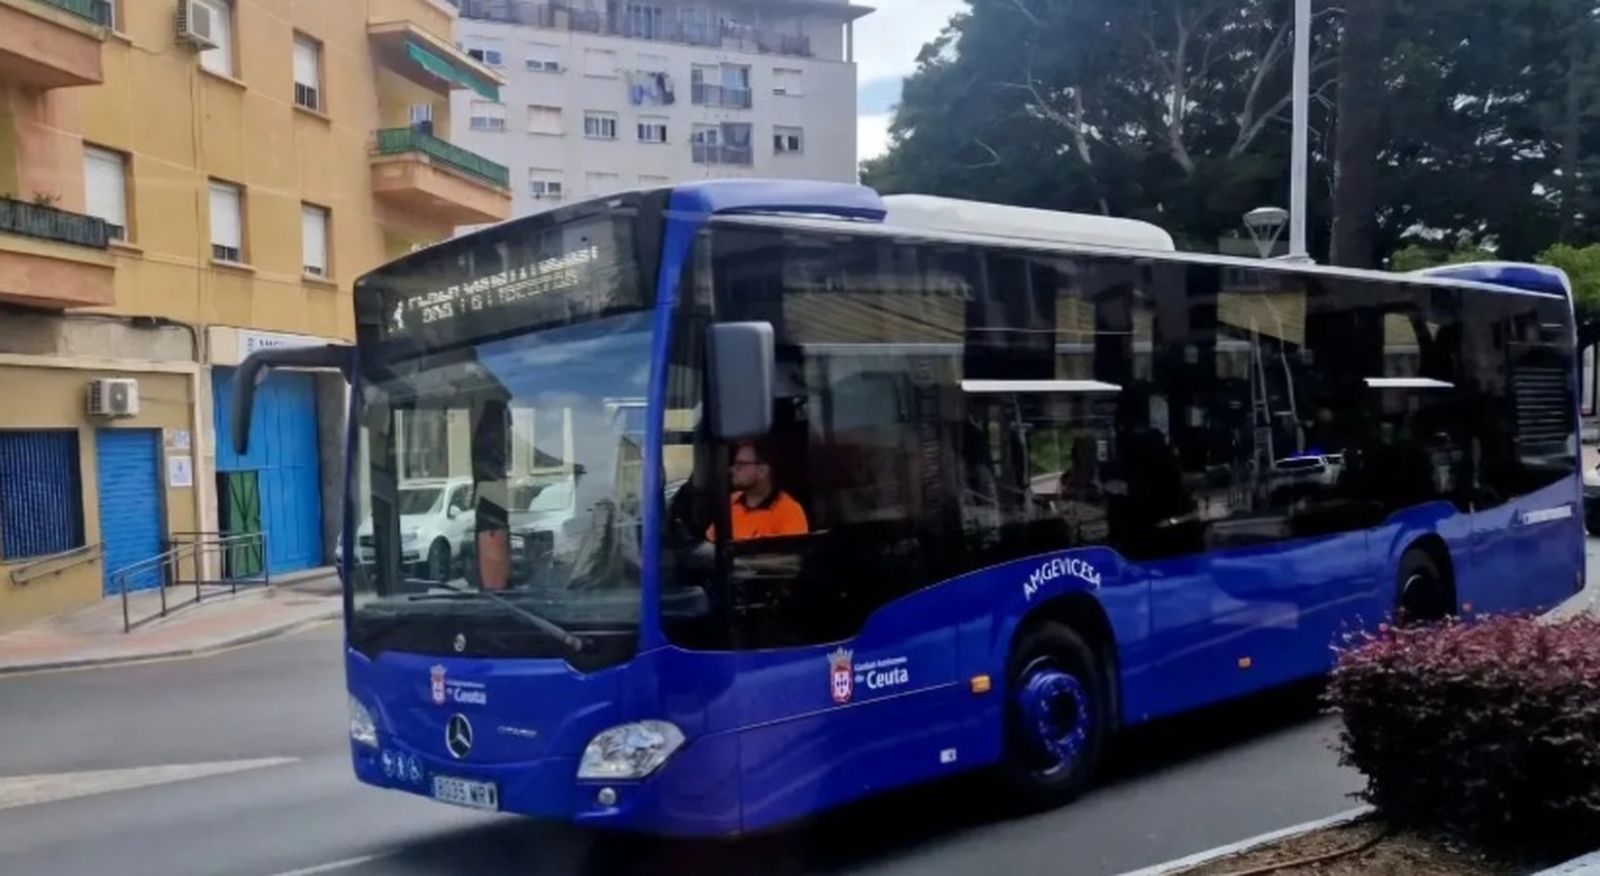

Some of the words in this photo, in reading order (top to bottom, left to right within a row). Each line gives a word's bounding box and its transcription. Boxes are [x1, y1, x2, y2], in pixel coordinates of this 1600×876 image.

[1023, 557, 1101, 601] AMGEVICESA
[866, 667, 909, 689] Ceuta
[453, 687, 487, 705] Ceuta
